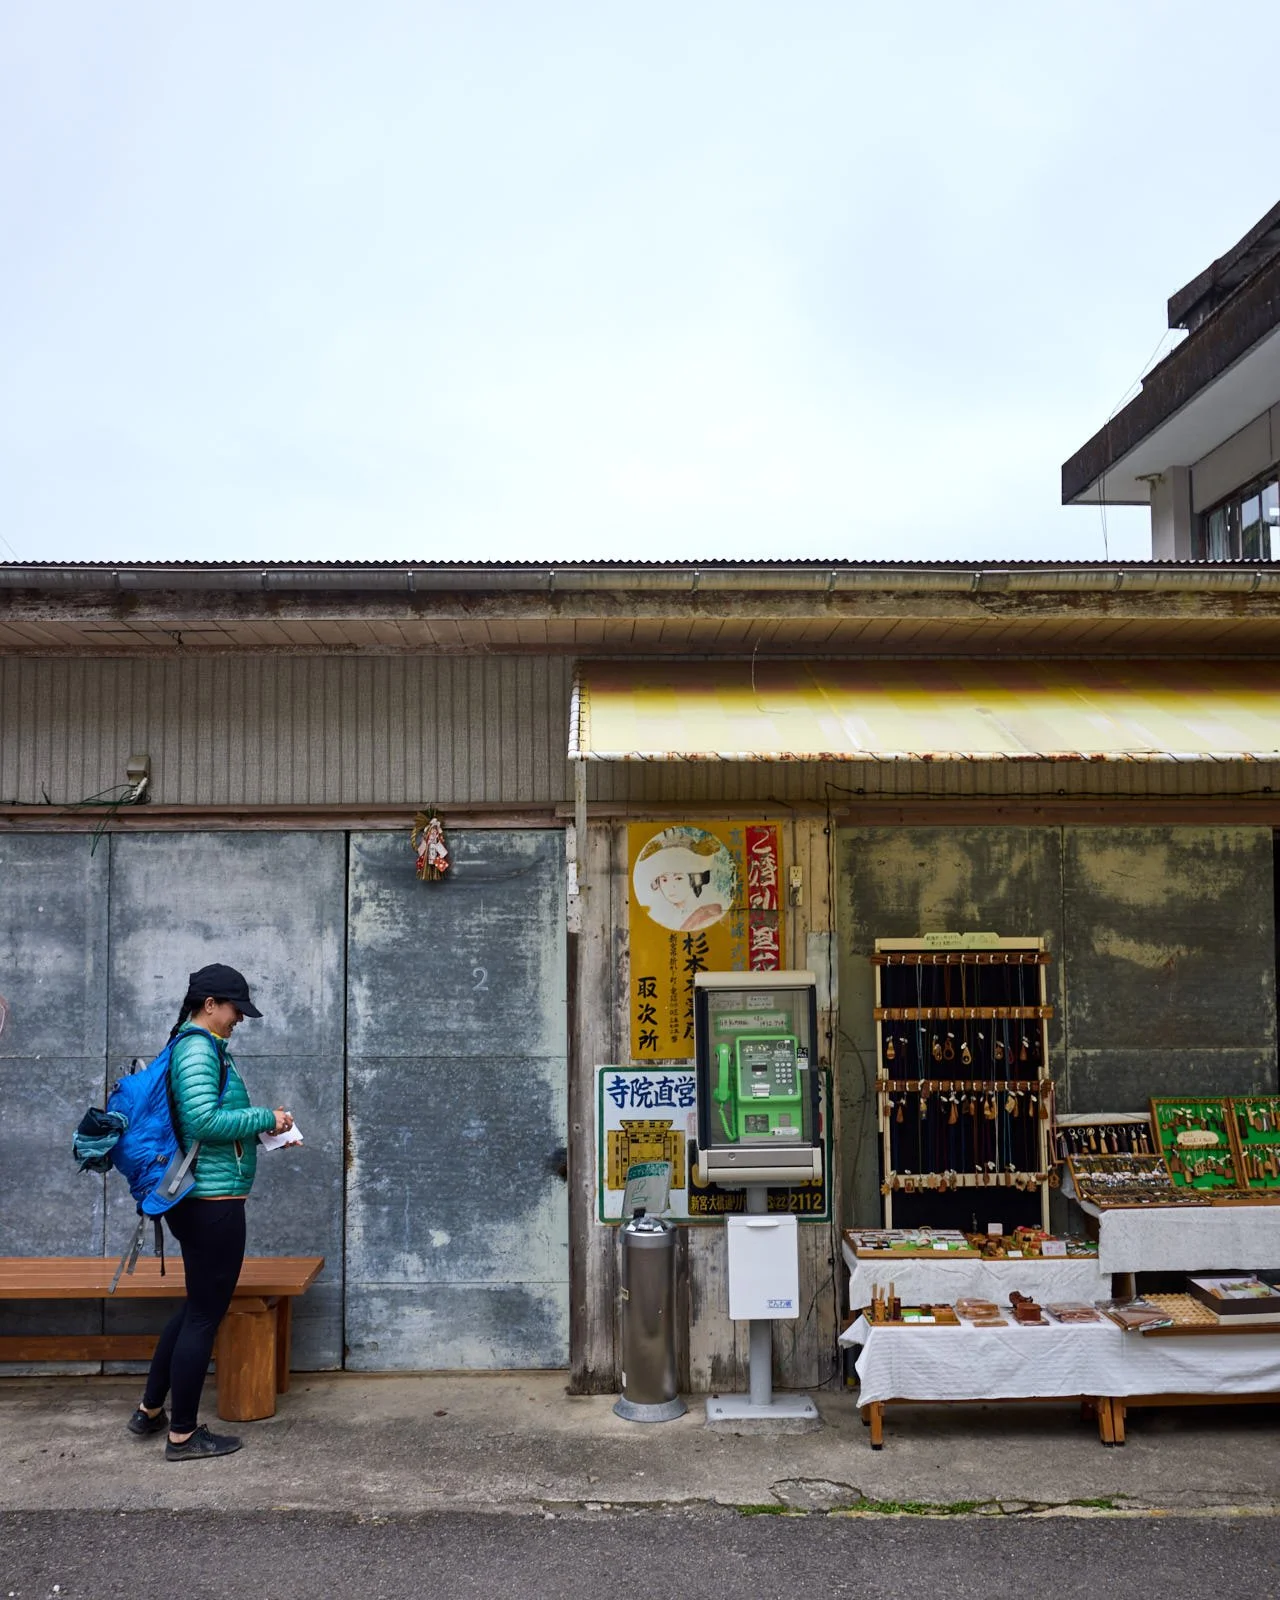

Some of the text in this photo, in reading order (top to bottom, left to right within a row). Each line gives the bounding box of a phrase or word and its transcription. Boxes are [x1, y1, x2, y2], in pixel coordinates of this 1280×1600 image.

[472, 967, 489, 991] 2
[637, 976, 659, 1052] 取次所
[606, 1075, 697, 1109] 寺院直営
[789, 1192, 823, 1210] 2112
